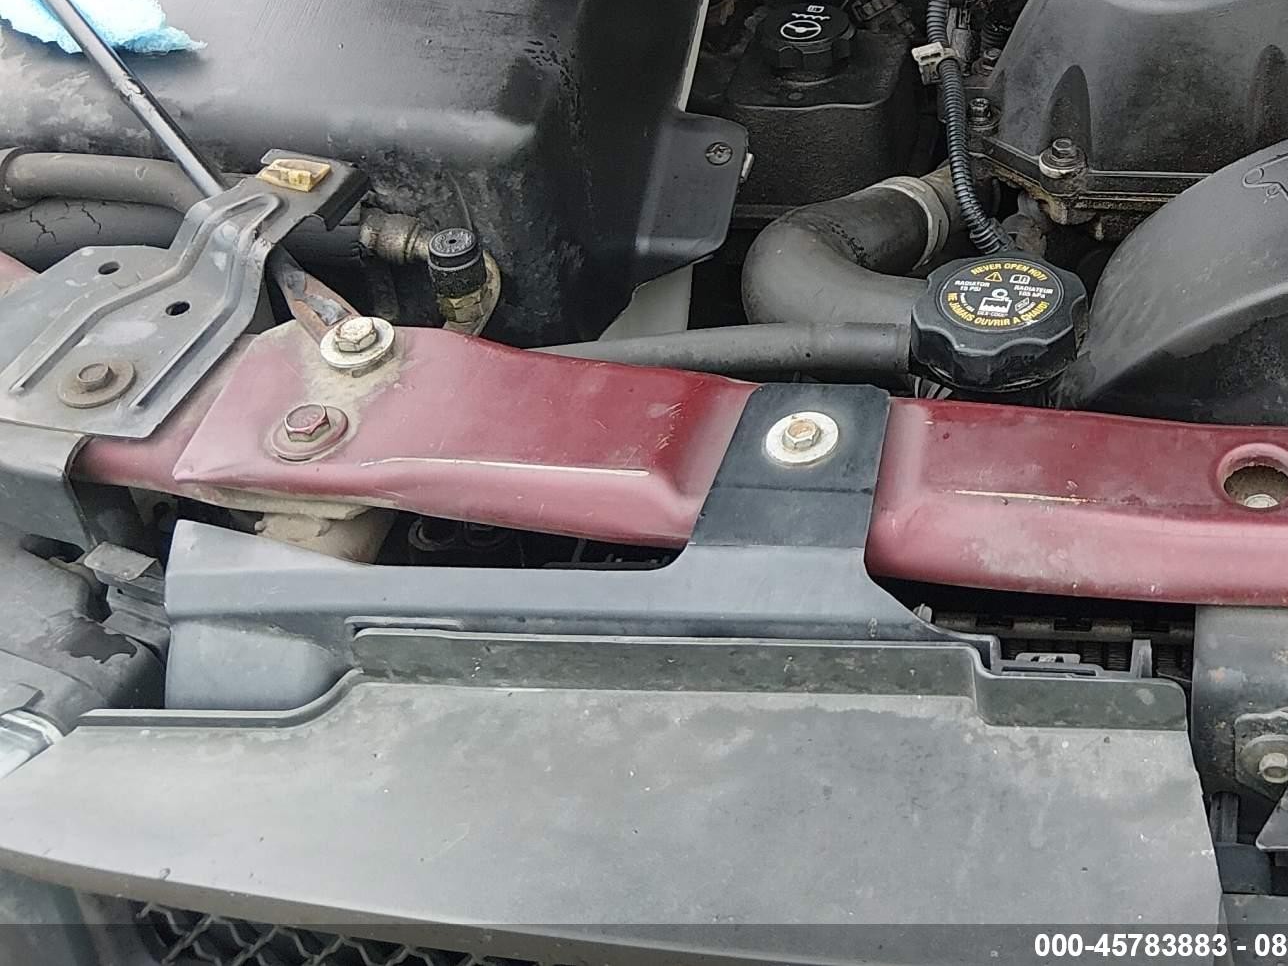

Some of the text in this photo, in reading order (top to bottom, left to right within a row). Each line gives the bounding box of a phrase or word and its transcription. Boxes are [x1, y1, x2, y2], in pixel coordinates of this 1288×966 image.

[970, 263, 1002, 275] NEVER
[1004, 262, 1030, 272] OPEN
[954, 280, 991, 288] RADIATOR
[1013, 284, 1054, 295] RADIATEUR
[974, 316, 1011, 326] OUVRIR
